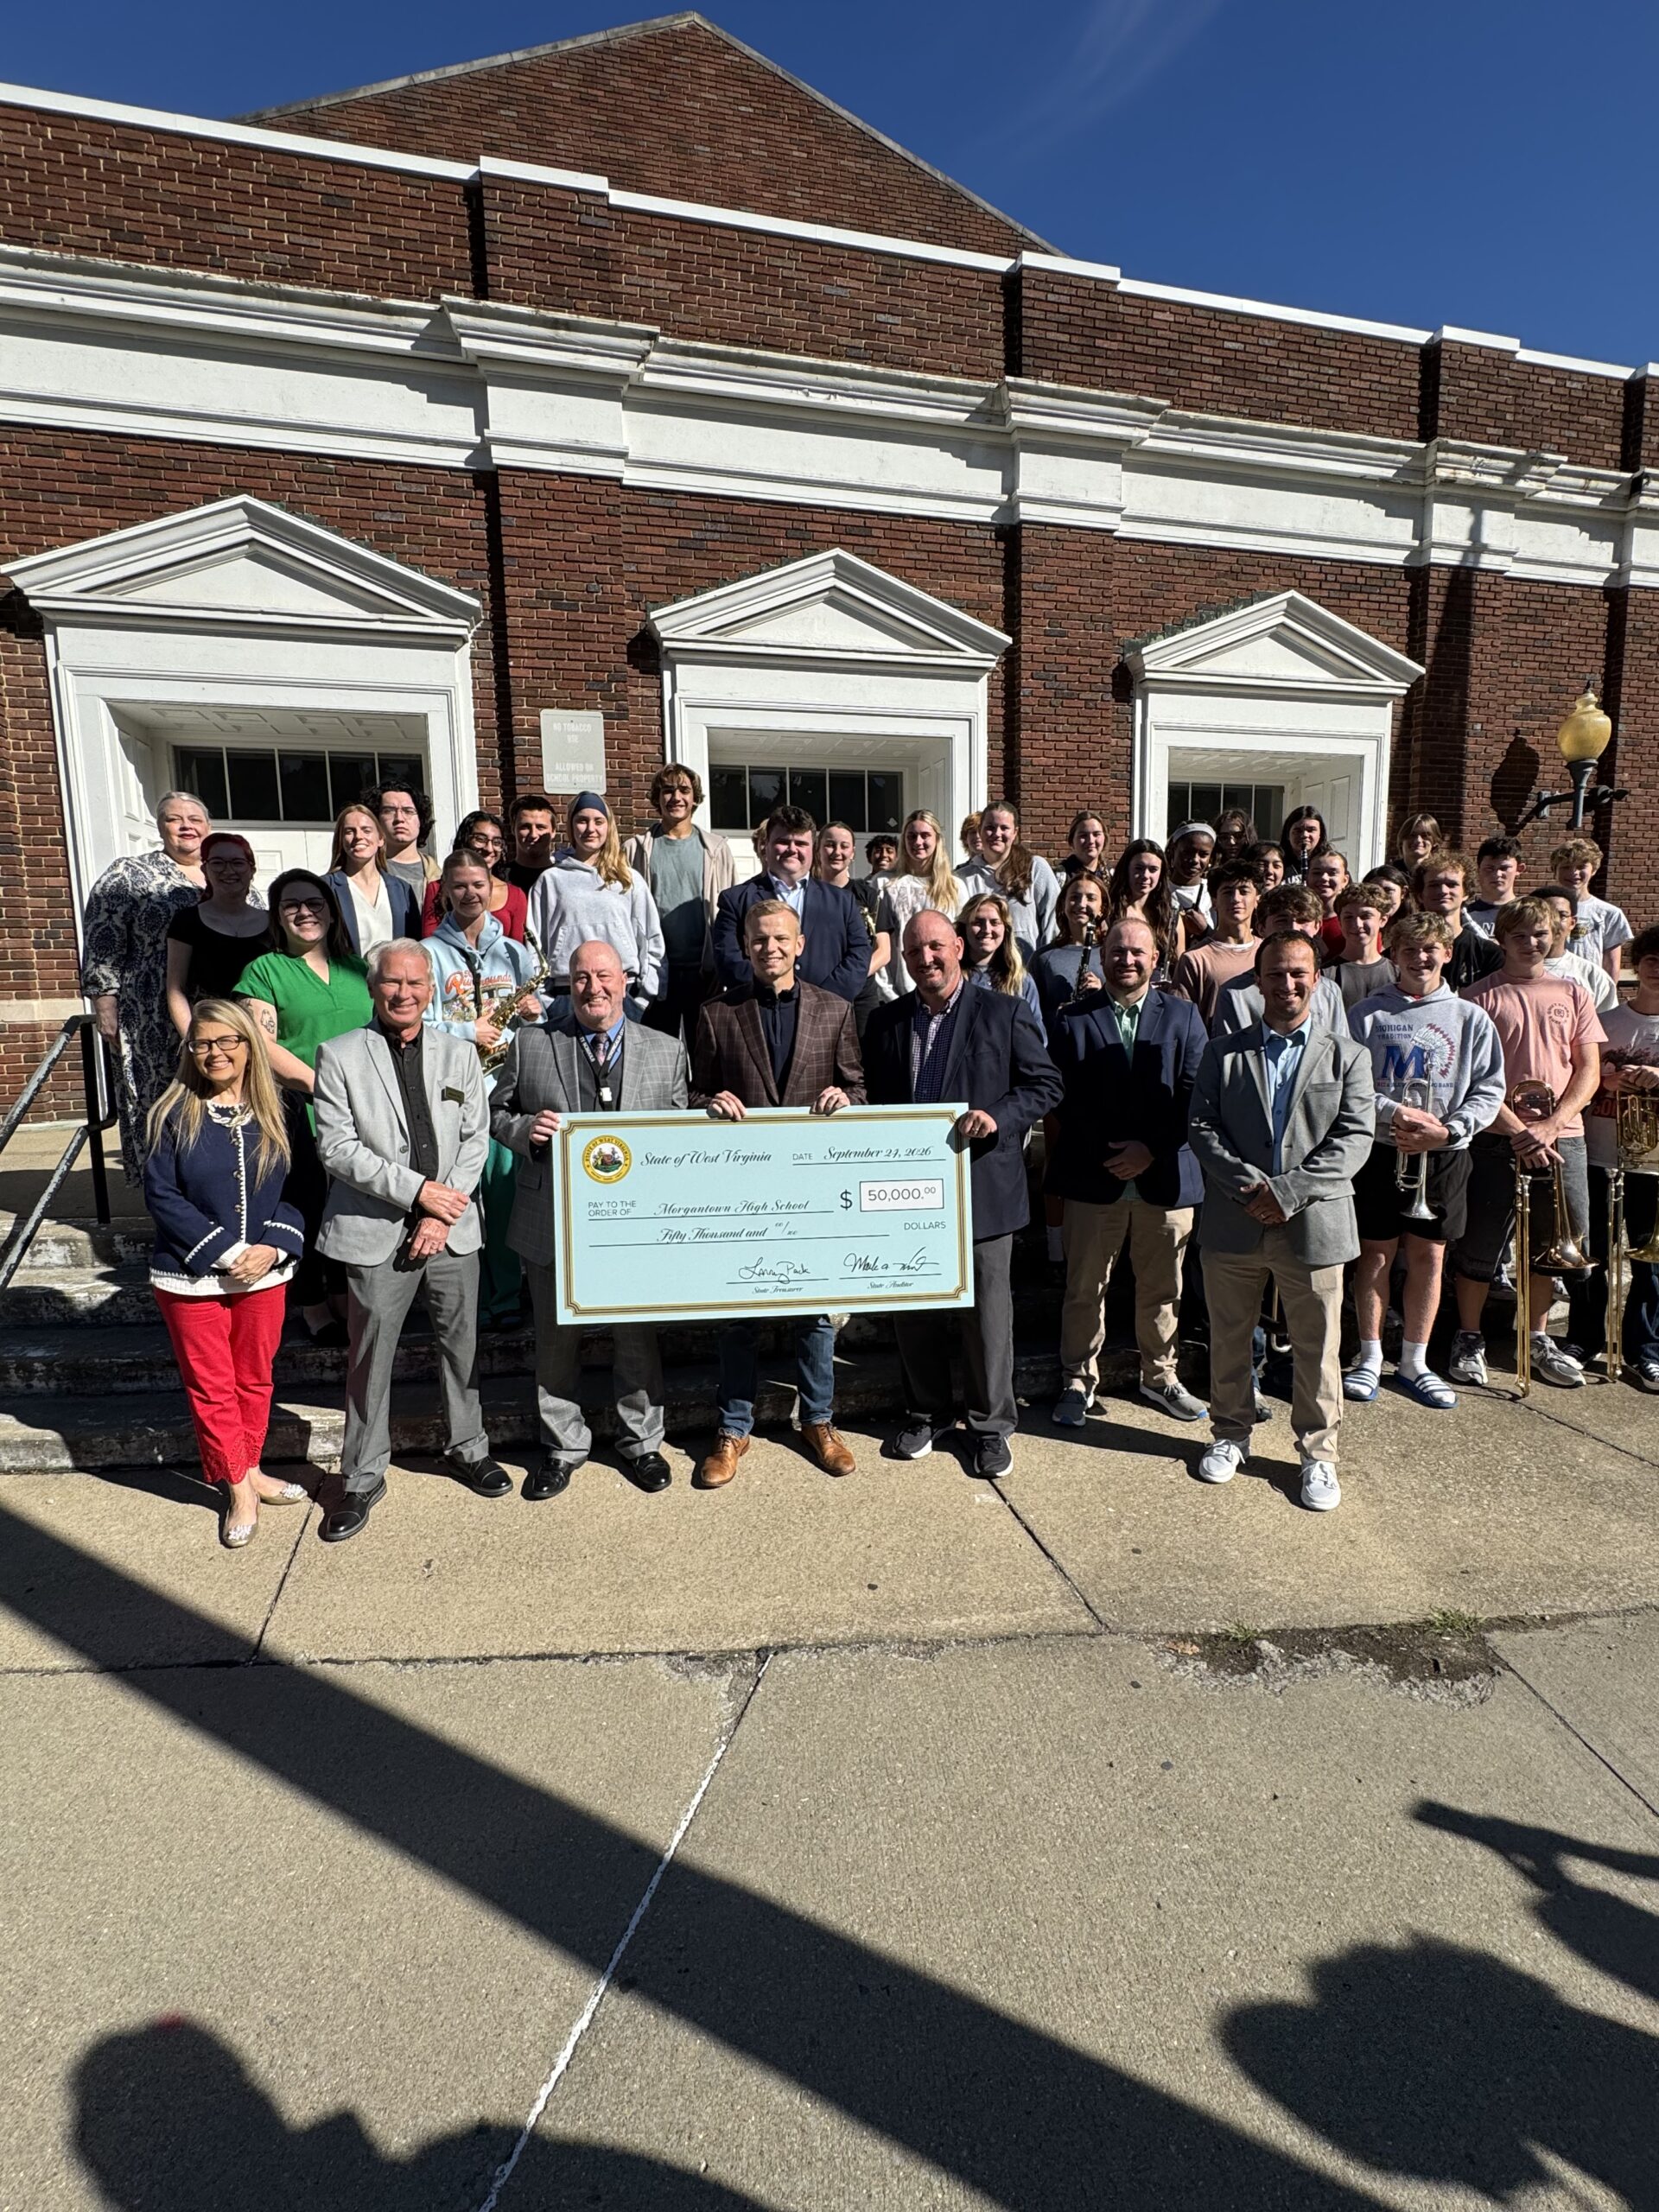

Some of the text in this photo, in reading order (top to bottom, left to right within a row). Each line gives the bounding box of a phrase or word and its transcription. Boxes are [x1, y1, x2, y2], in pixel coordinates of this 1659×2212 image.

[563, 722, 592, 733] TOBACCO
[555, 762, 583, 772] ALLOWED
[546, 773, 603, 783] SCHOOL PROPERTY
[1375, 1024, 1414, 1033] MOHIGAN
[1381, 1044, 1427, 1079] M
[640, 1149, 772, 1167] State of West Virginia
[823, 1146, 883, 1162] September
[904, 1146, 934, 1157] 2026
[653, 1199, 811, 1217] Morgantown High School
[840, 1189, 853, 1211] $
[904, 1221, 946, 1230] DOLLARS
[657, 1228, 687, 1244] Fifty
[689, 1227, 743, 1242] Thousand
[746, 1228, 768, 1238] and
